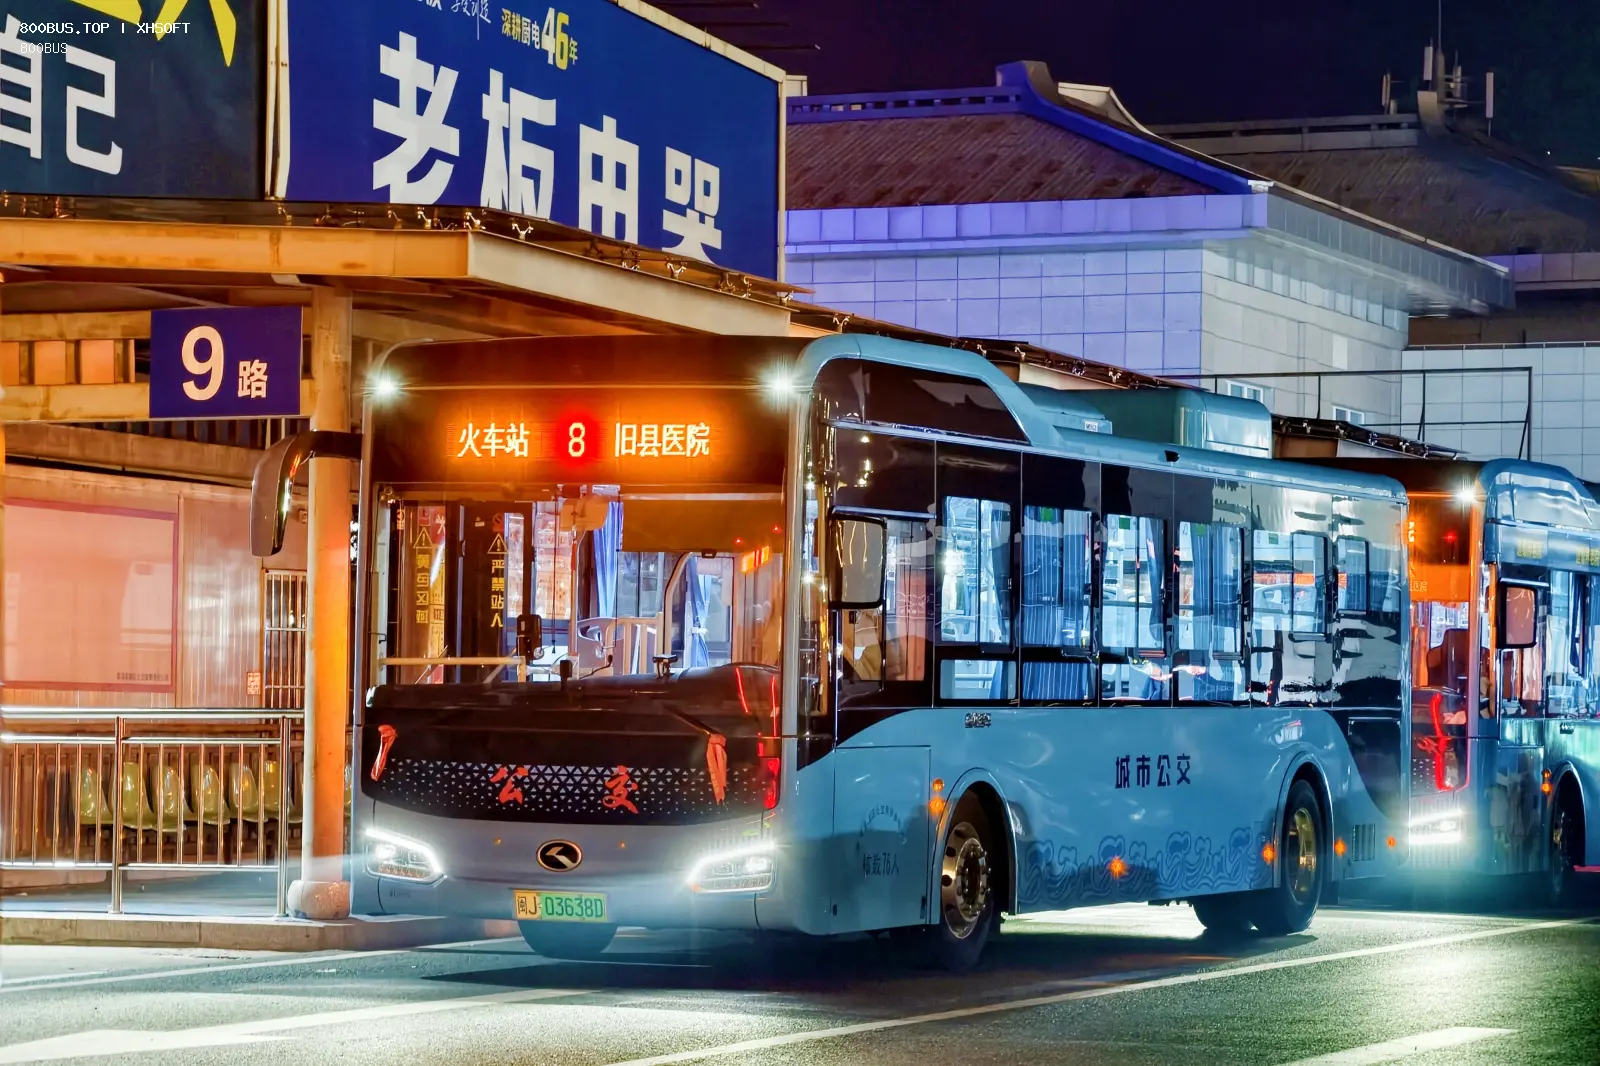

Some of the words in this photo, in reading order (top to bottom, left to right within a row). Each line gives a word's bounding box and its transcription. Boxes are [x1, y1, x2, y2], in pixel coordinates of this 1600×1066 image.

[502, 7, 578, 70] 深耕厨电46年
[457, 422, 530, 457] 火车站
[568, 422, 586, 457] 8
[614, 423, 711, 457] 旧县医院
[1115, 753, 1191, 788] 城市公交
